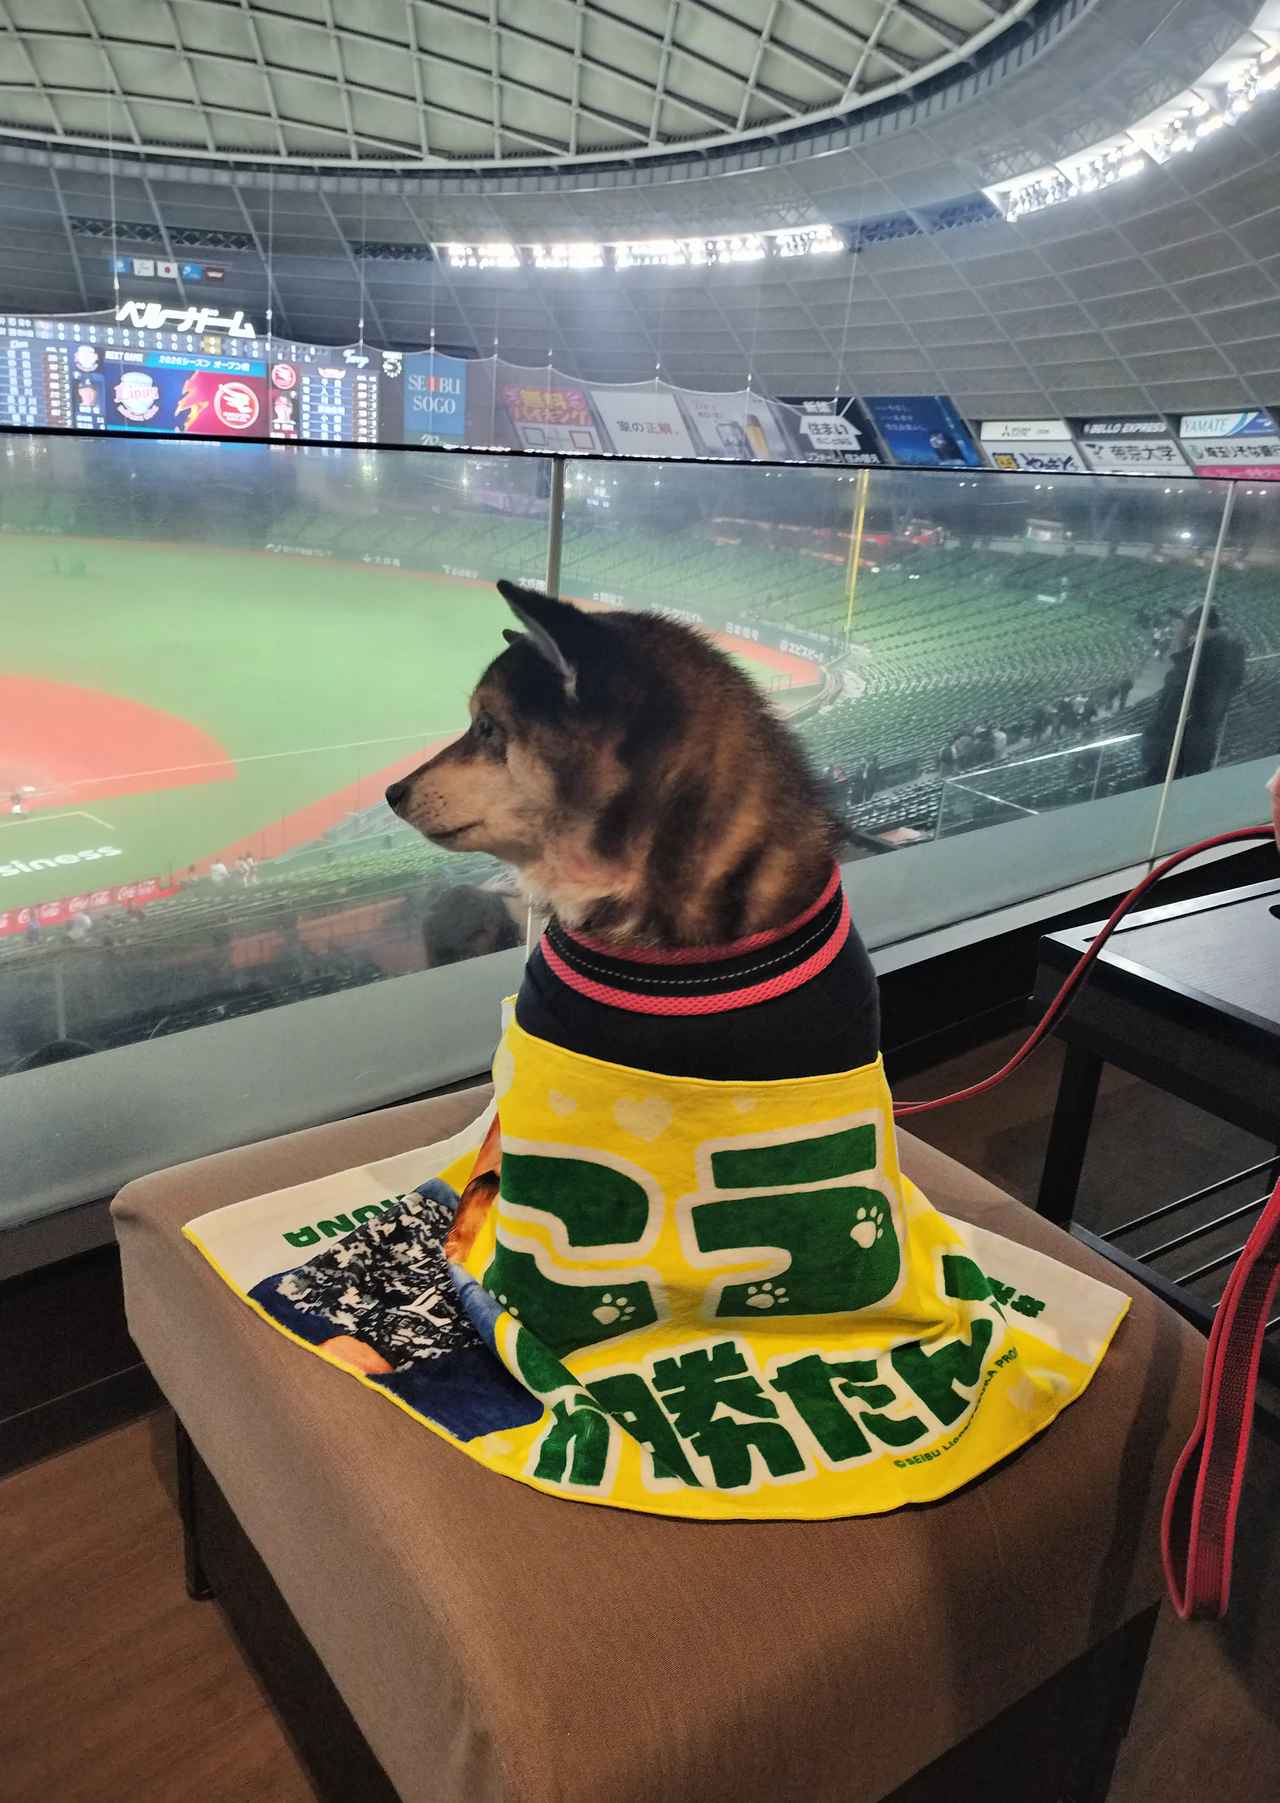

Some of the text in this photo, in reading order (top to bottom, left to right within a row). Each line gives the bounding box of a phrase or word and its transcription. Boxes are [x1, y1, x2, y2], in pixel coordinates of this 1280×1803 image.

[116, 301, 256, 338] ベルーナドーム
[105, 350, 123, 361] NEXT
[408, 375, 461, 395] SEIBU
[412, 397, 456, 415] SOGO
